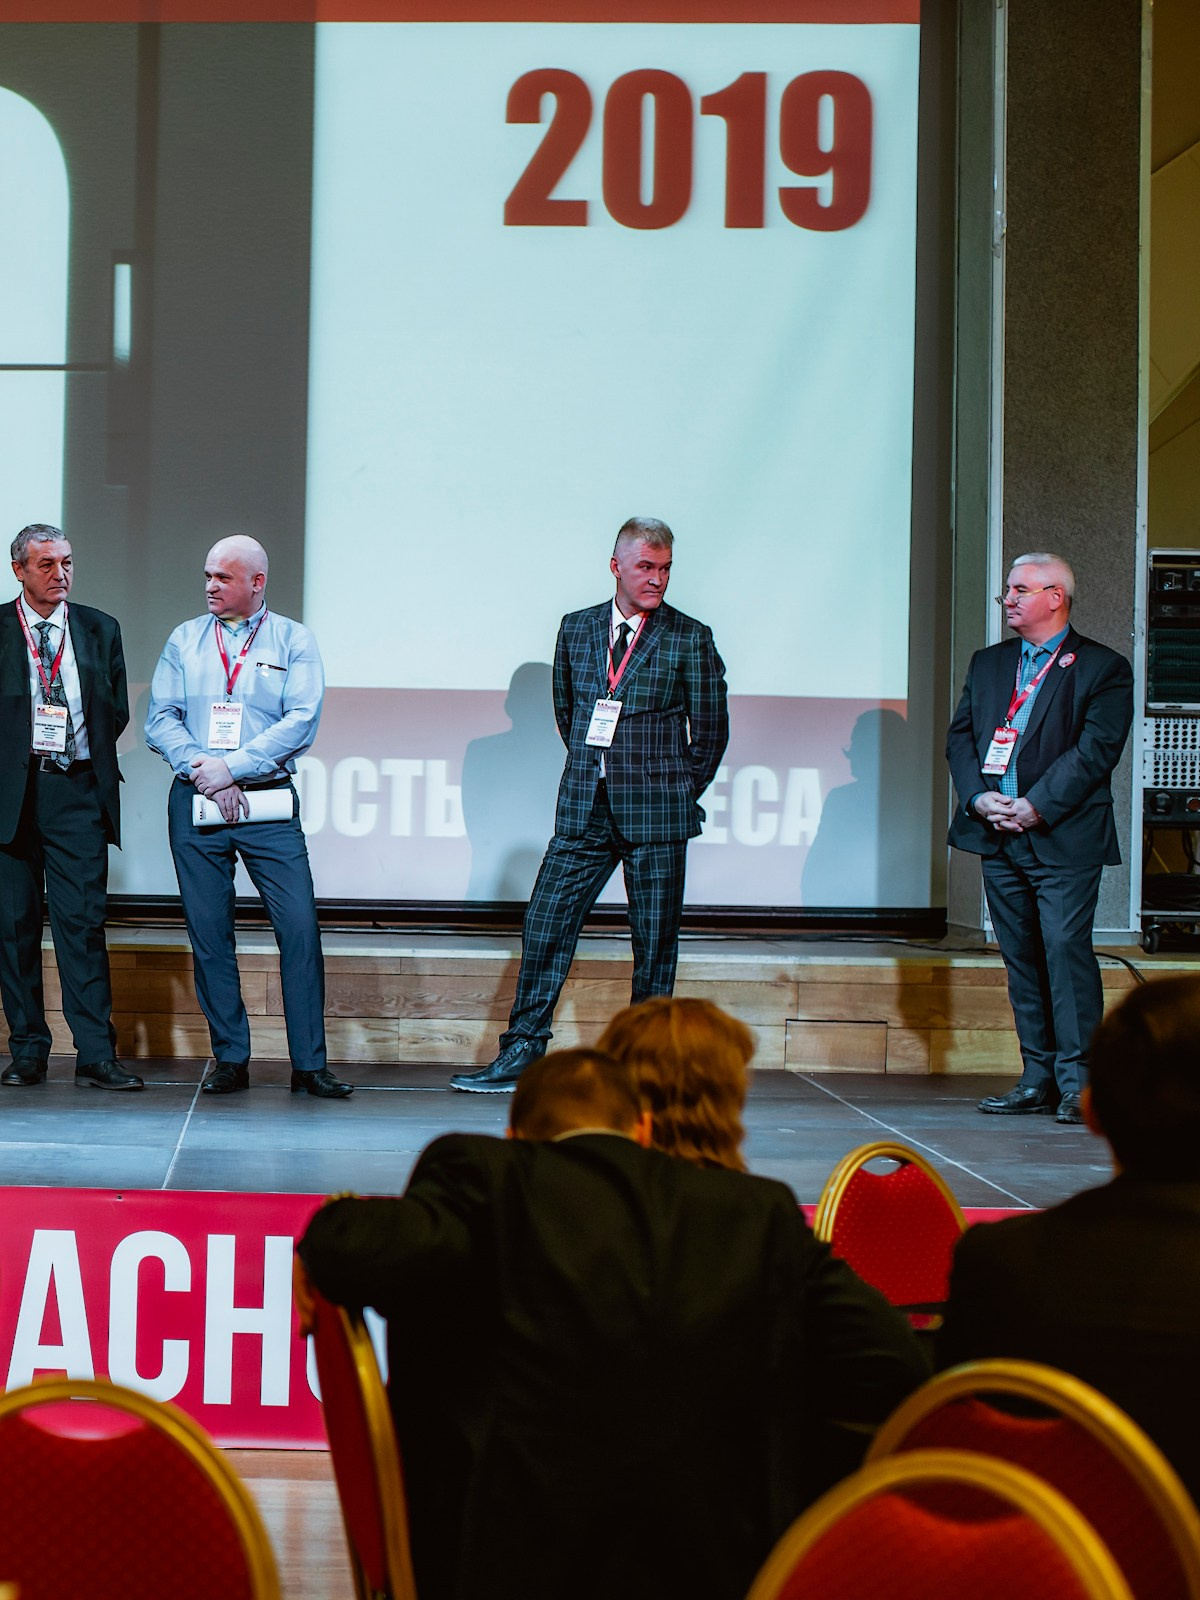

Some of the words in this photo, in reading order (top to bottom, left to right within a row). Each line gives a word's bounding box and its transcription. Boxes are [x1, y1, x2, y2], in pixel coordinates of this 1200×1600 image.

[503, 67, 873, 232] 2019
[291, 756, 467, 837] ОСТЬ
[689, 765, 822, 846] ЕСА
